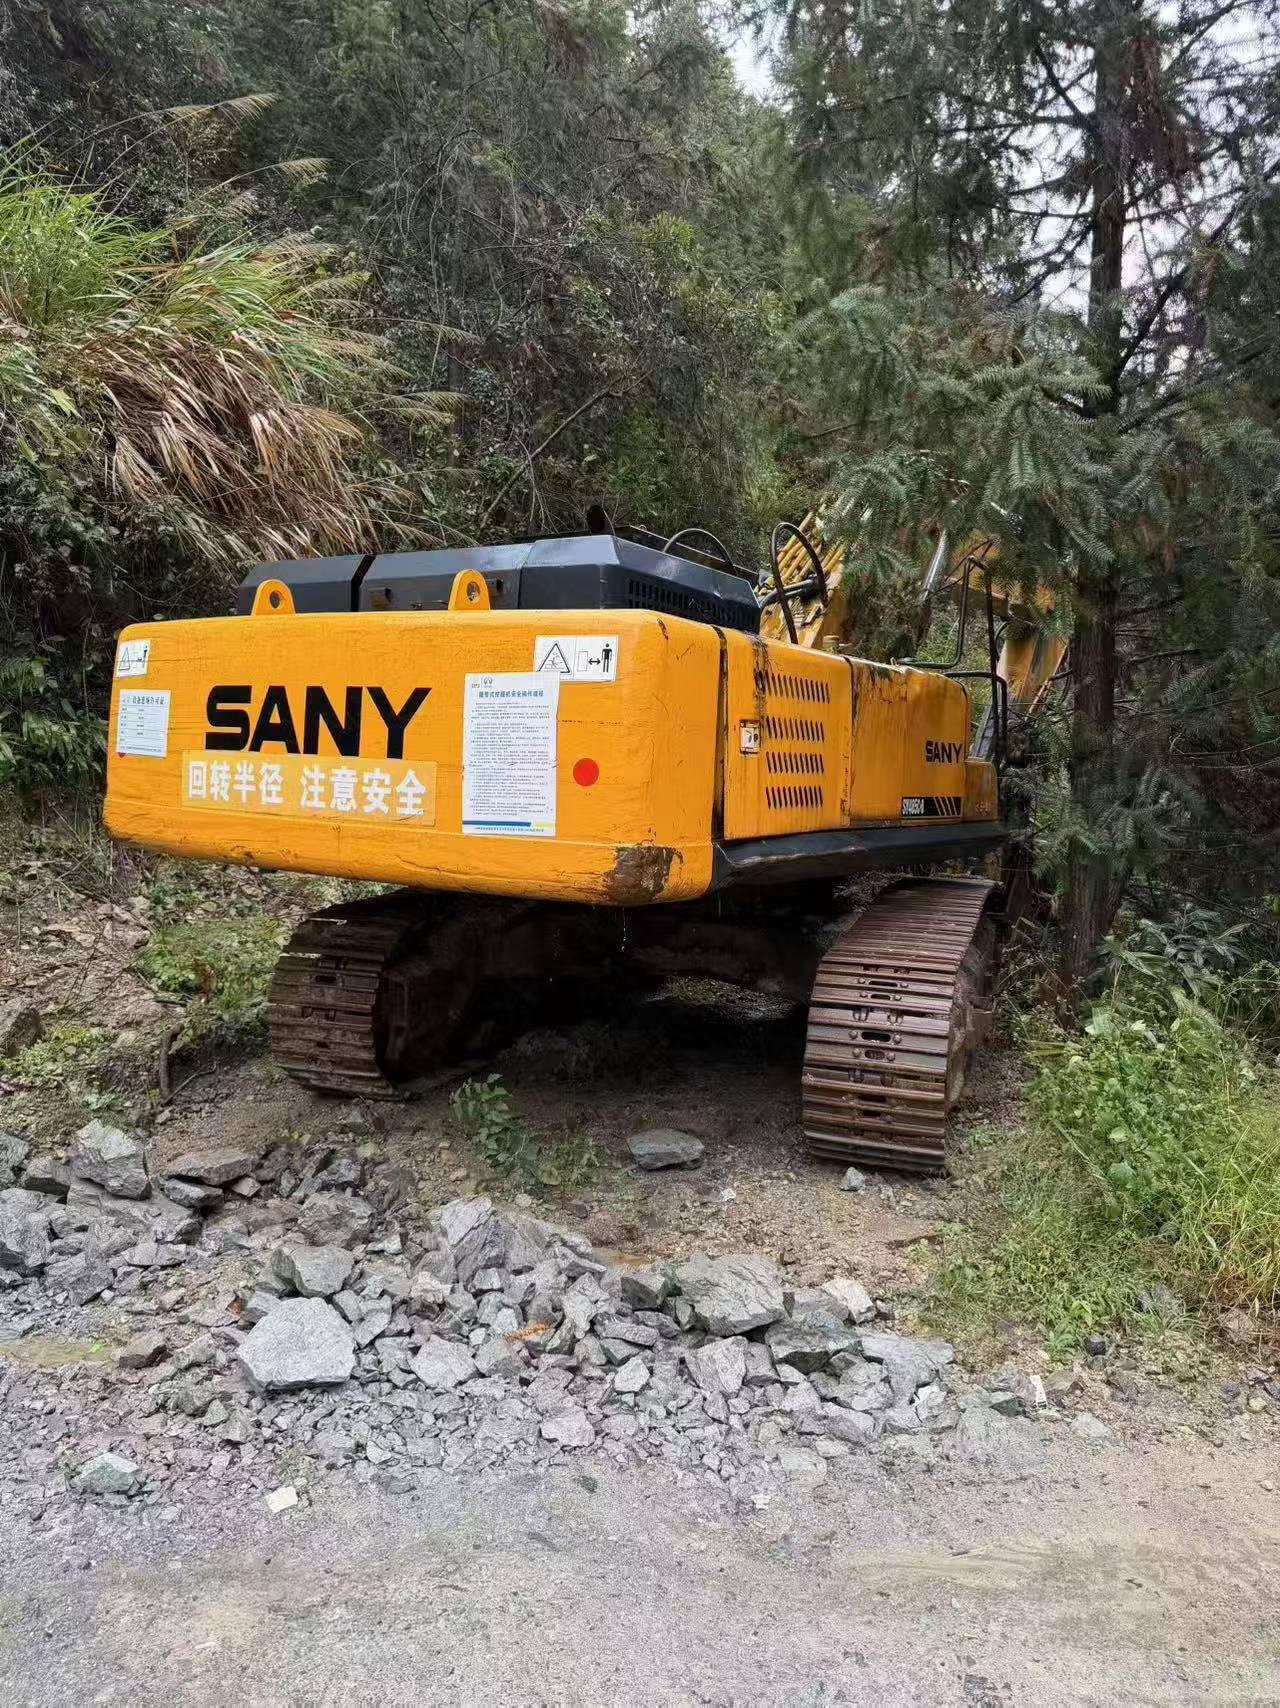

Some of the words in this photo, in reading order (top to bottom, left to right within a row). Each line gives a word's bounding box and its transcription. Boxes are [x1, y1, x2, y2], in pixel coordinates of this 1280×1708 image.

[205, 685, 432, 759] SANY
[926, 740, 963, 764] SANY
[188, 760, 284, 805] 回转半径
[301, 764, 426, 815] 注意安全
